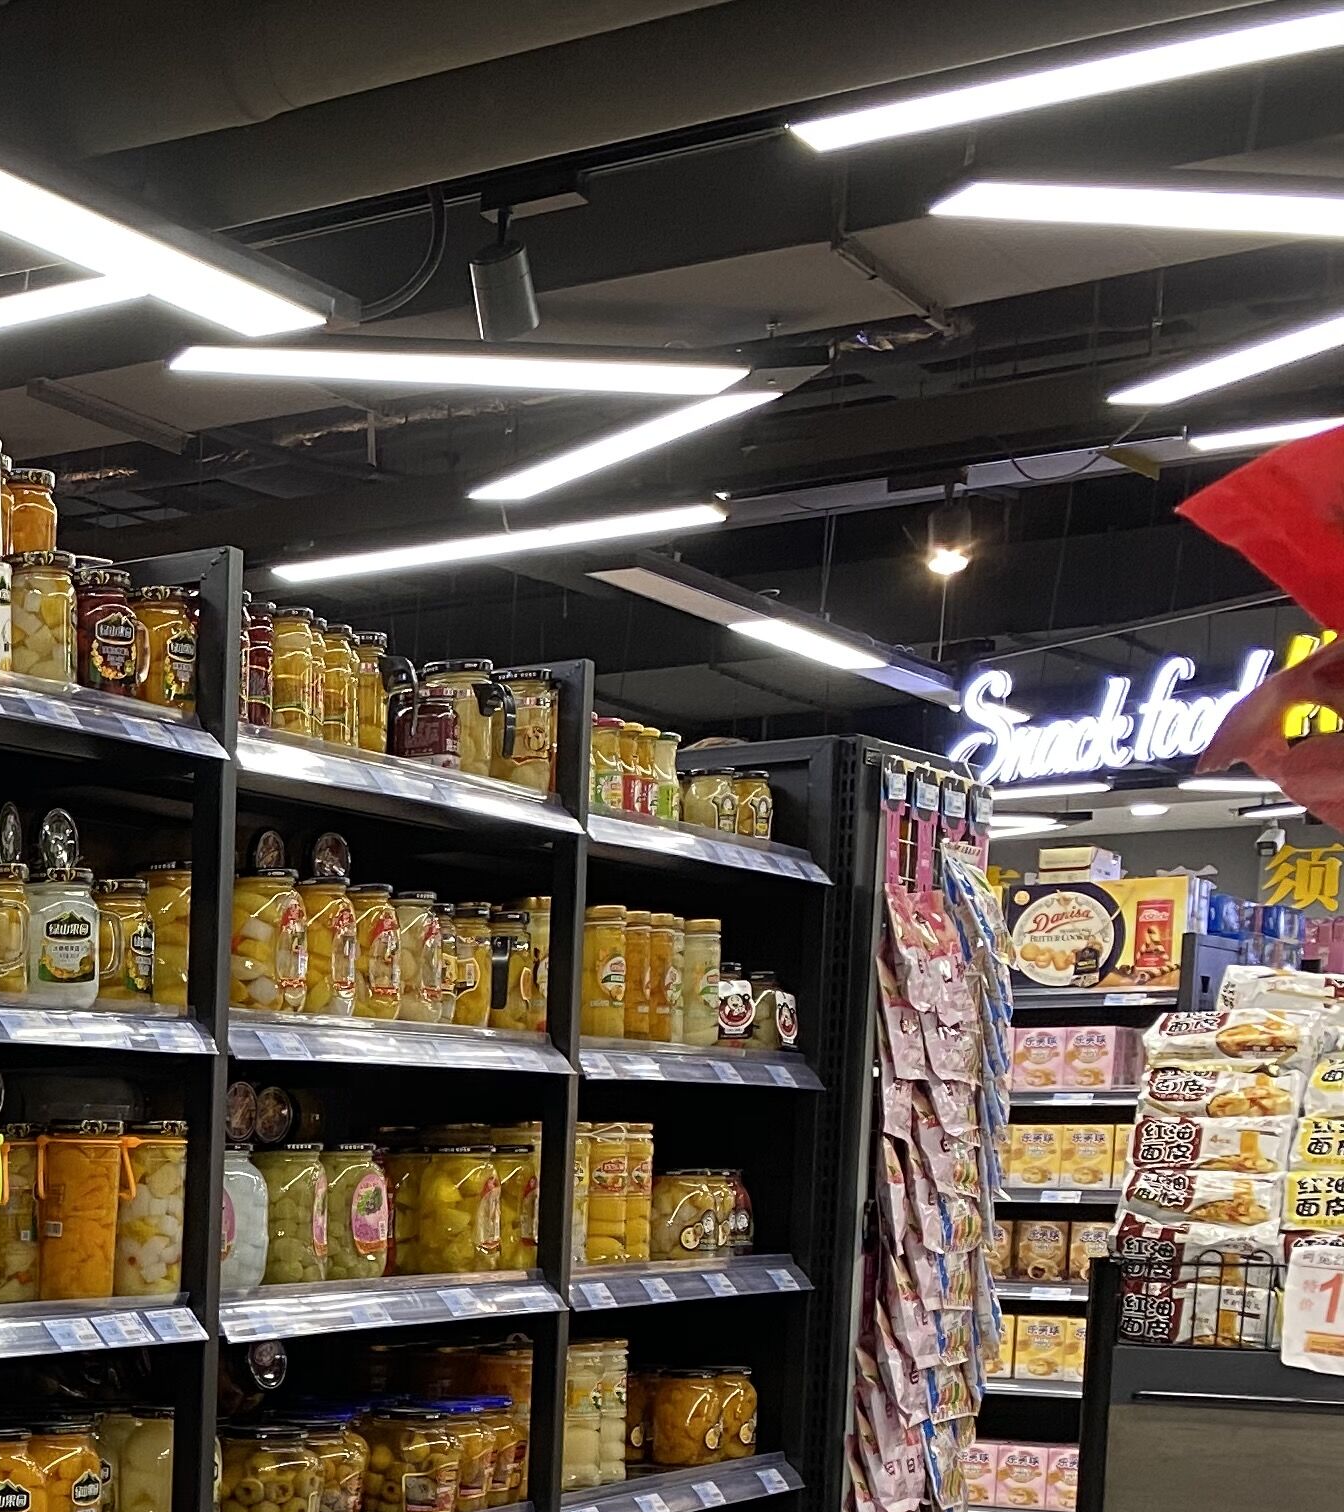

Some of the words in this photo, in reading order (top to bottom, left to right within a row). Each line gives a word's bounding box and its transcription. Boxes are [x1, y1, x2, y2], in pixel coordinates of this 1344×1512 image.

[947, 670, 1133, 785] Snack
[48, 923, 89, 936] 绿山果园
[1027, 906, 1095, 934] Danisa
[1144, 1124, 1194, 1141] 红油
[1140, 1144, 1191, 1161] 面皮
[1124, 1237, 1176, 1256] 红油
[1123, 1295, 1175, 1316] 红油
[1121, 1317, 1169, 1339] 面皮
